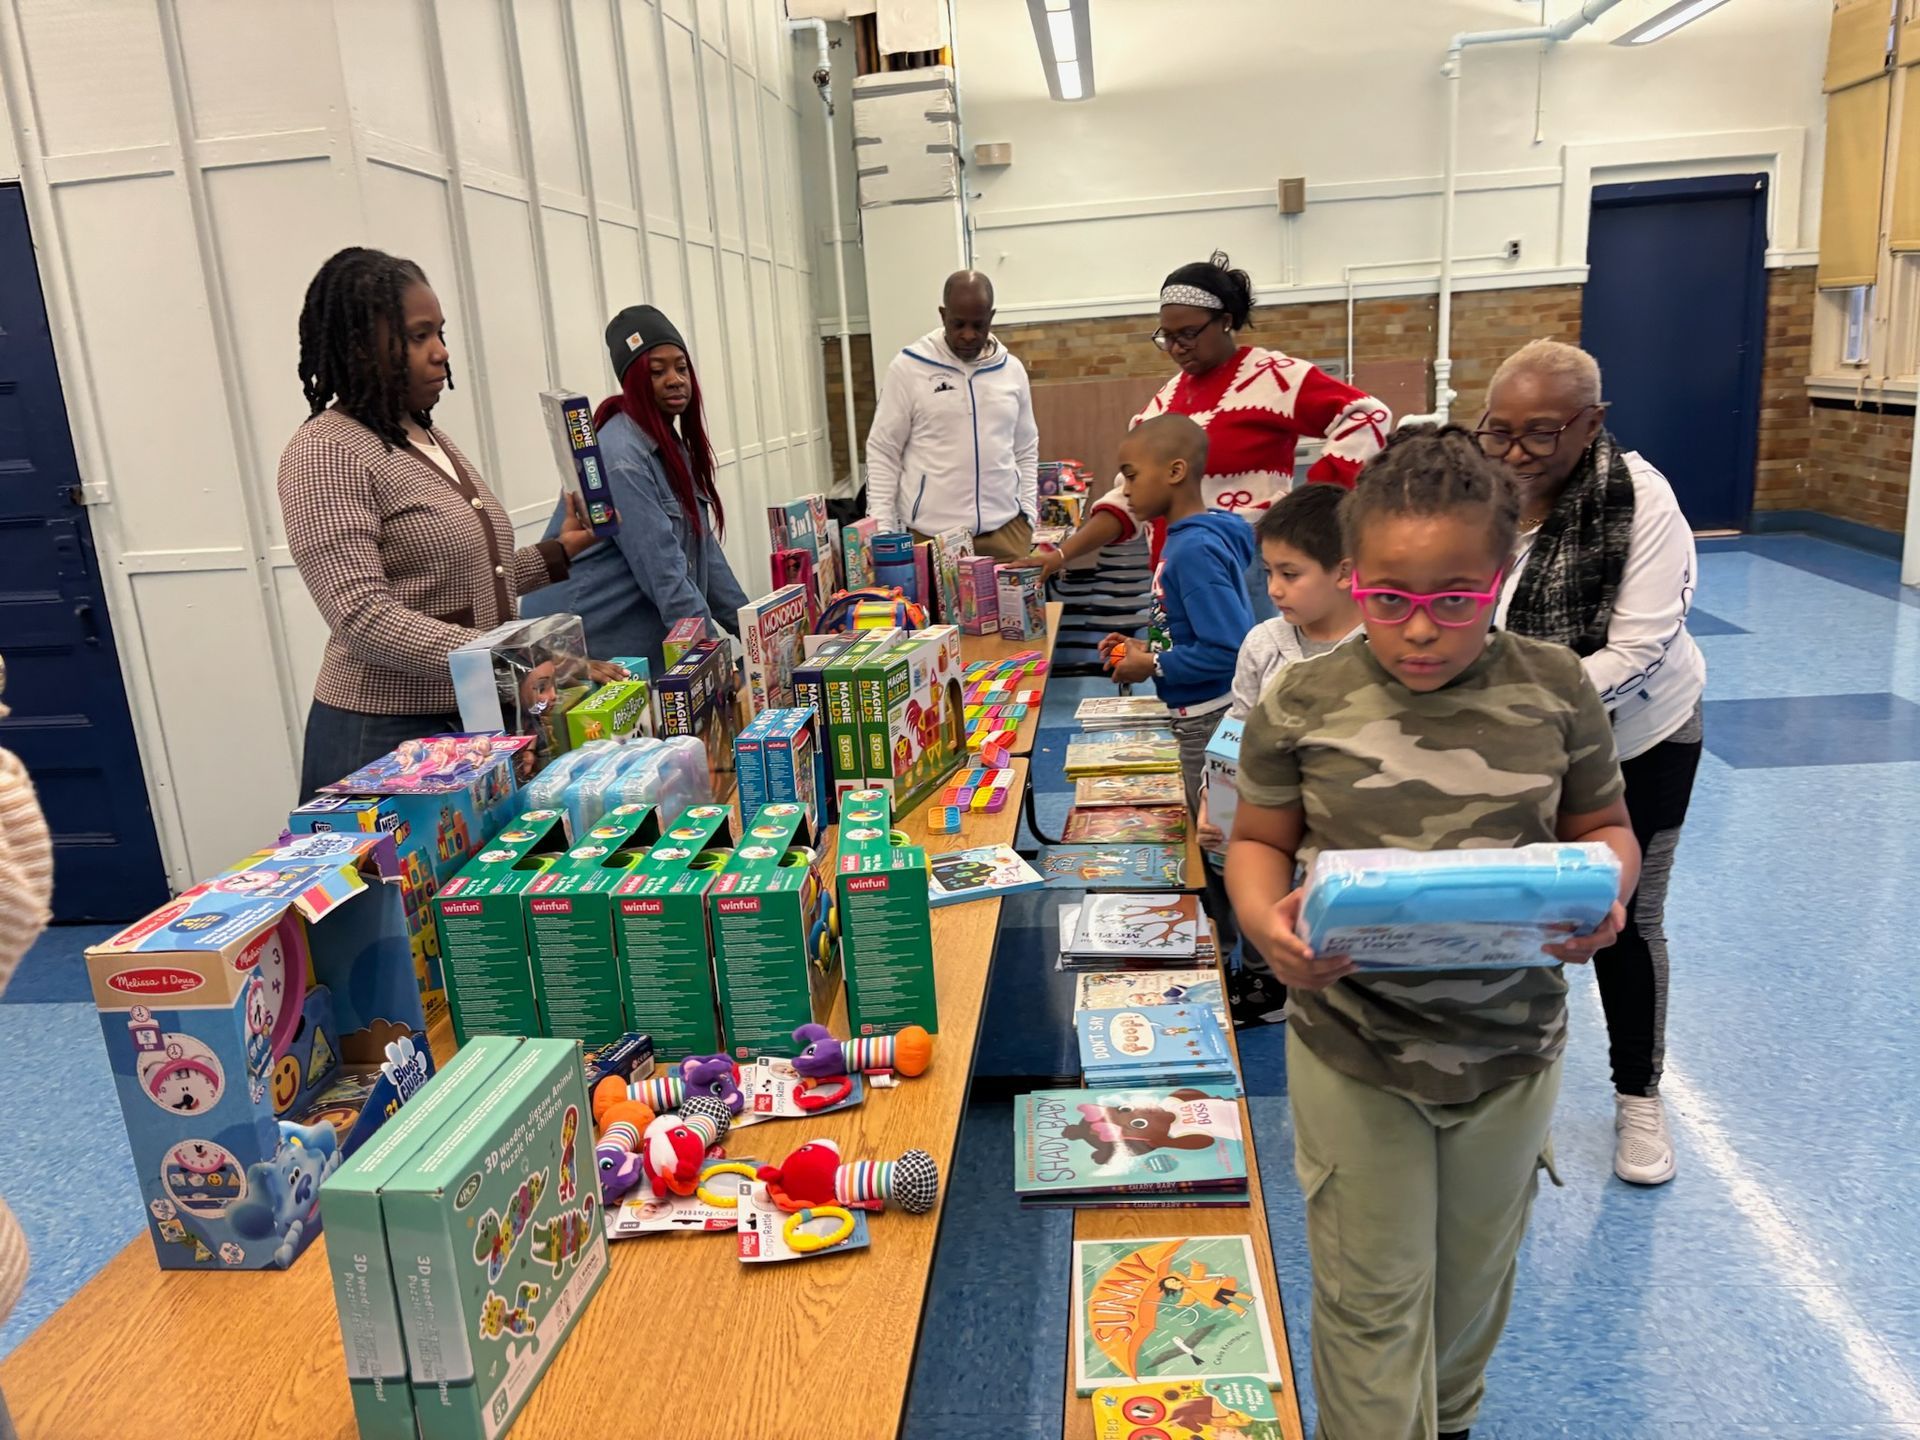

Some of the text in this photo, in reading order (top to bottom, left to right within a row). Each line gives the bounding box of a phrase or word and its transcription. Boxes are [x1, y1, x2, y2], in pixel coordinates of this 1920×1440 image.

[568, 409, 586, 449] BUILDS
[577, 408, 594, 448] MAGNE
[763, 597, 805, 635] MONOPOLY
[664, 692, 678, 735] BUILDS
[674, 692, 688, 734] MAGNE
[829, 682, 843, 725] BUILDS
[838, 681, 852, 724] MAGNE
[861, 680, 874, 723] BUILDS
[871, 680, 883, 722] MAGNE
[850, 878, 886, 890] winfun
[444, 903, 480, 914] winfun
[533, 902, 570, 913] winfun
[624, 902, 660, 912] winfun
[720, 900, 758, 911] winfun
[272, 948, 281, 964] 3
[116, 975, 160, 988] Melissa
[170, 974, 196, 990] Doug
[272, 981, 282, 994] 4
[1088, 1016, 1110, 1059] DON'T SAY
[393, 1055, 420, 1085] Blue's
[484, 1066, 574, 1174] 3D Wooden Jigsaw Animal
[1193, 1102, 1212, 1125] BOSS
[500, 1098, 564, 1174] Puzzle for children
[1036, 1098, 1076, 1182] SHADY BABY
[354, 1254, 368, 1273] 3D
[417, 1256, 432, 1275] 3D
[1092, 1251, 1156, 1342] SUNNY
